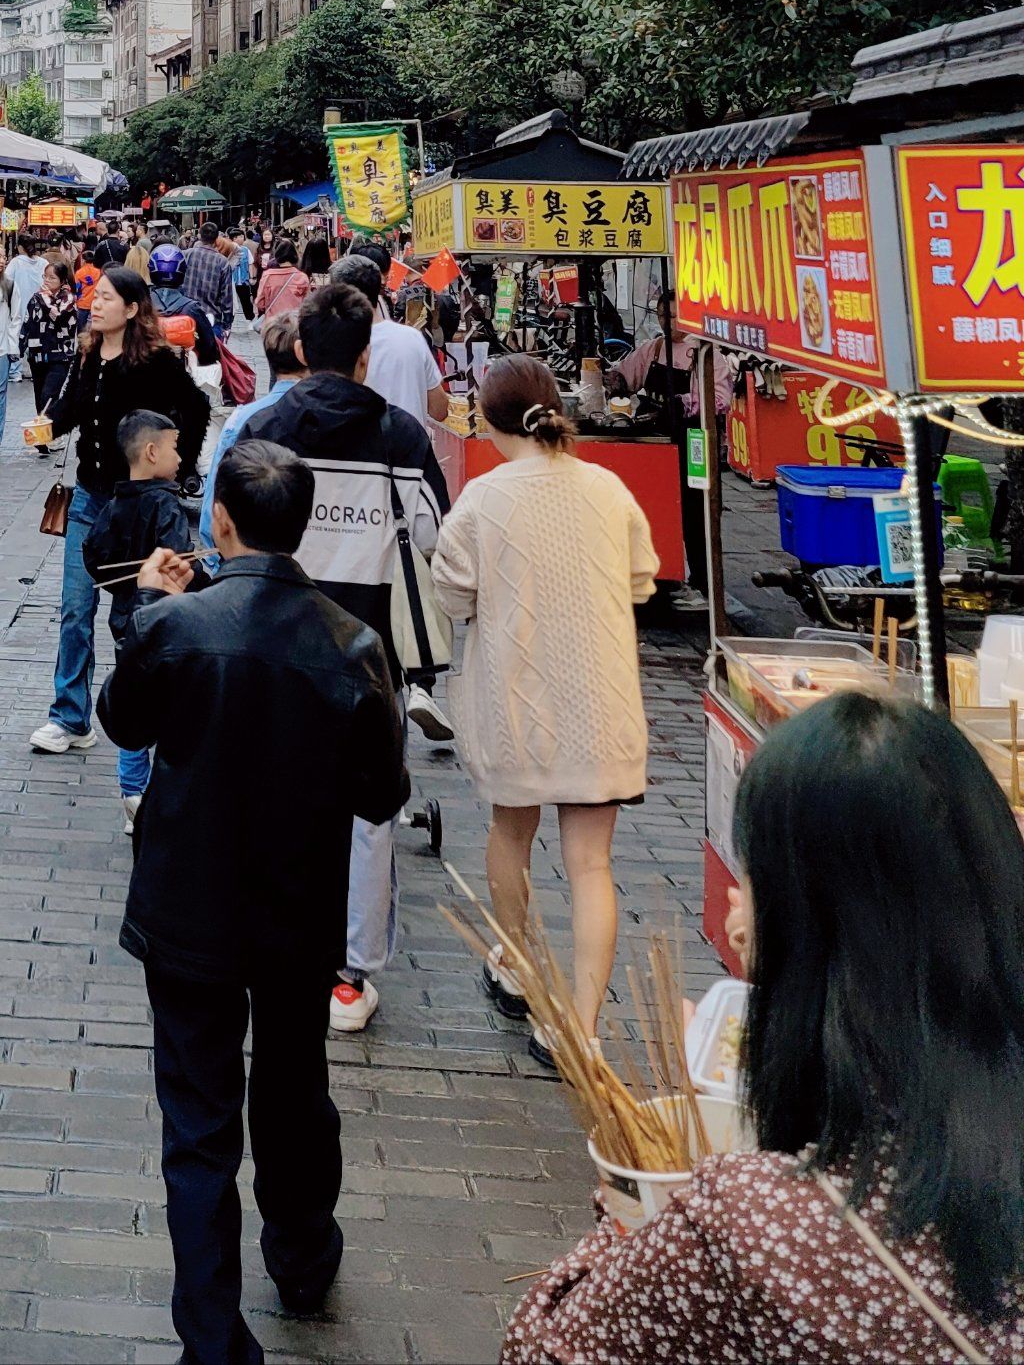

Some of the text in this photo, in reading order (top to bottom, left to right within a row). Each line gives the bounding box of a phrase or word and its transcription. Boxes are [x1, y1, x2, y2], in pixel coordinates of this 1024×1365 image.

[356, 156, 387, 224] 臭豆腐
[475, 188, 520, 216] 臭美
[542, 188, 654, 227] 臭豆腐
[554, 228, 643, 249] 包浆豆腐
[674, 181, 799, 324] 龙凤爪爪
[925, 183, 956, 286] 入口细腻
[951, 316, 1024, 344] 藤椒凤
[731, 417, 748, 467] 99
[309, 504, 390, 528] OCRACY
